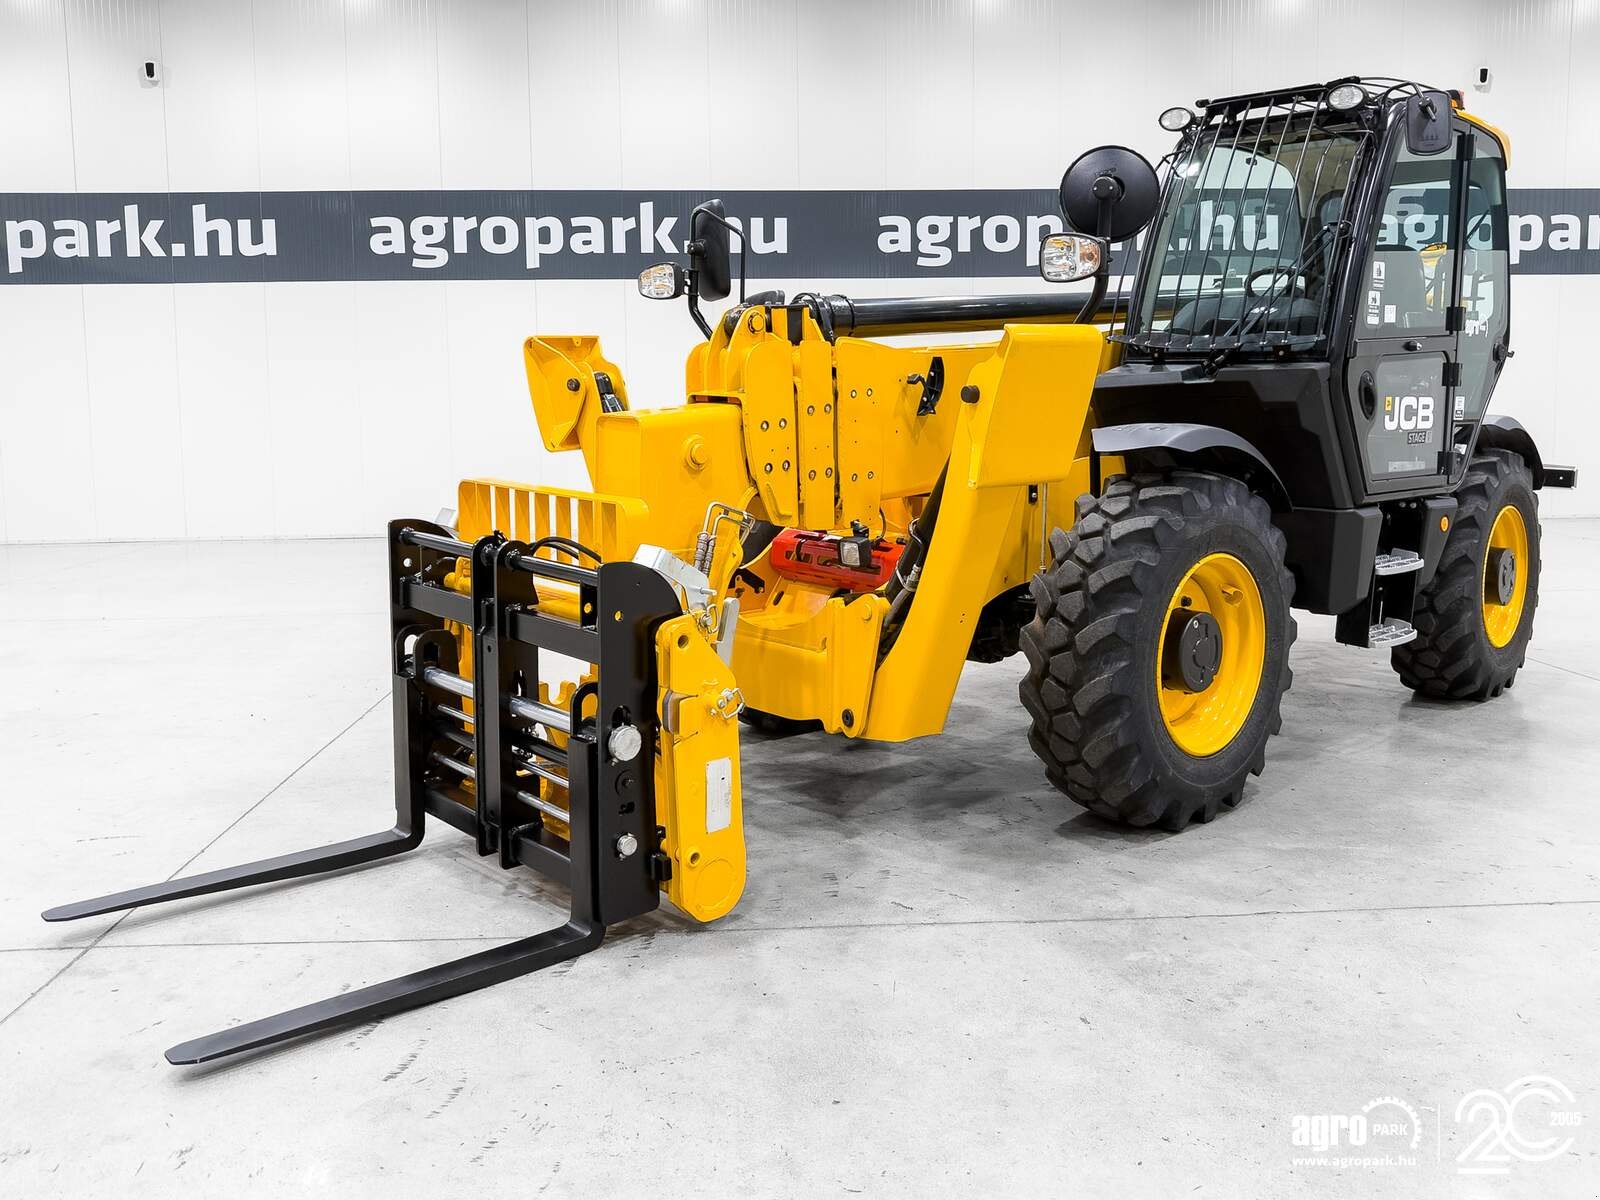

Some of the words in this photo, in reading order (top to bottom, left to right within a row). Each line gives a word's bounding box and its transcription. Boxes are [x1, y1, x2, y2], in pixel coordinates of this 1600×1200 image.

[5, 203, 278, 274] park.hu
[1384, 396, 1435, 431] JCB
[1408, 431, 1426, 444] STAGE
